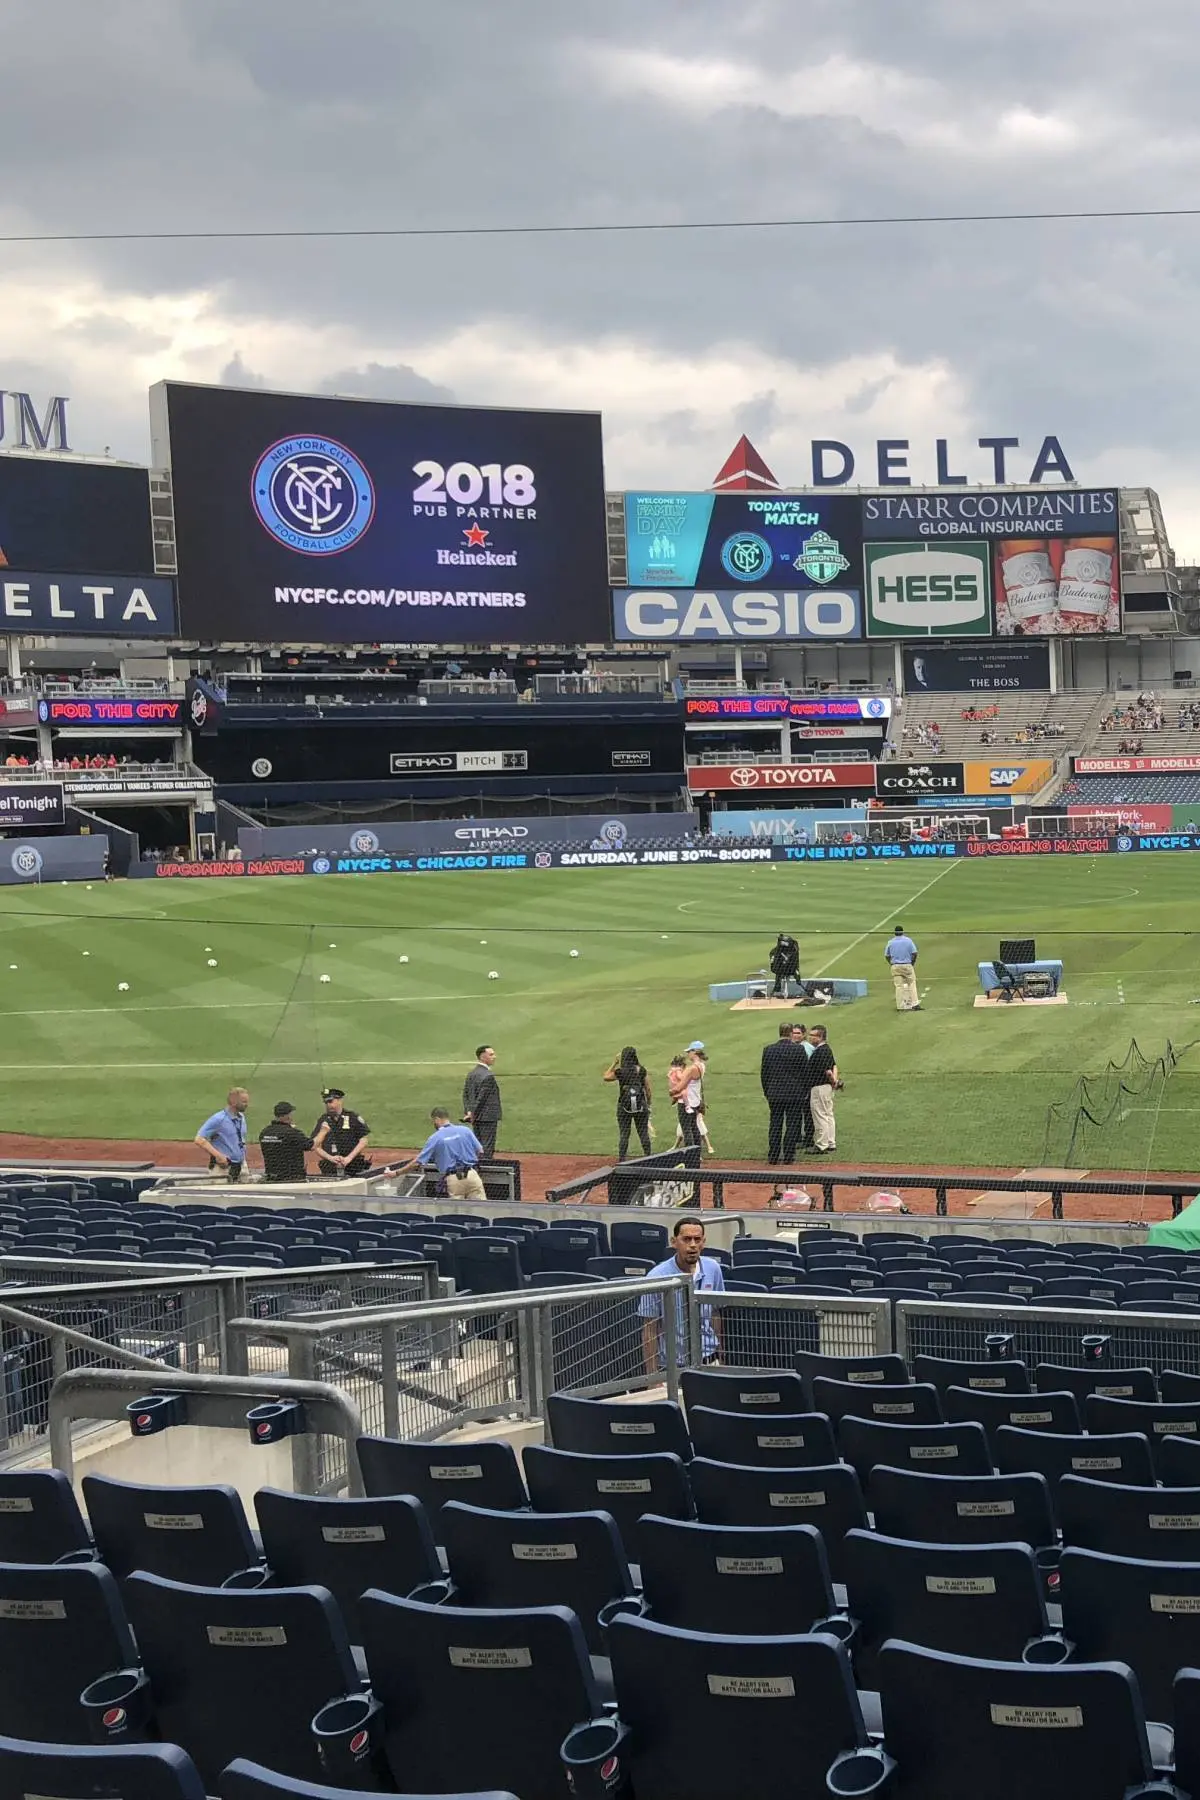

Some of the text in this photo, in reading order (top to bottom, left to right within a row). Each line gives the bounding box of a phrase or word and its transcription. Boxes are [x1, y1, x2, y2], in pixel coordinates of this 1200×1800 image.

[270, 441, 352, 466] NEW YORK CITY
[811, 436, 1075, 486] DELTA
[412, 460, 536, 506] 2018
[636, 497, 674, 505] WELCOME
[747, 501, 800, 512] TODAY'S
[866, 492, 1115, 520] STARR COMPANIES
[413, 504, 537, 519] PUB PARTNER
[637, 505, 687, 517] FAMILY
[765, 512, 819, 525] MATCH
[637, 517, 686, 535] DAY
[919, 519, 1063, 535] GLOBAL INSURANCE
[274, 523, 359, 550] FOOTBALL CLUB
[436, 549, 518, 566] Heineken
[801, 555, 841, 563] TORONTO
[878, 575, 978, 603] HESS
[275, 586, 526, 608] NYCFC.COM/PUBPARTNERS
[624, 592, 856, 636] CASIO
[969, 677, 1020, 688] THE BOSS
[51, 703, 92, 718] FOR
[95, 703, 133, 718] THE
[137, 703, 179, 718] CITY
[687, 701, 719, 713] FOR
[721, 700, 751, 712] THE
[754, 699, 789, 712] CITY
[814, 729, 845, 737] TOYOTA
[395, 755, 496, 768] ETIHAD PITCH
[613, 752, 648, 761] ETIHAD
[1080, 759, 1130, 771] MODELL'S
[761, 768, 836, 783] TOYOTA
[882, 776, 958, 788] COACH
[989, 770, 1018, 785] SAP
[850, 798, 886, 809] FedEx
[455, 826, 529, 839] ETIHAD
[156, 861, 244, 877] UPCOMING
[247, 859, 305, 874] MATCH
[337, 858, 391, 871] NYCFC
[395, 860, 412, 869] vs.
[416, 856, 487, 870] CHICAGO
[492, 854, 527, 867] FIRE
[561, 852, 637, 865] SATURDAY,
[640, 851, 679, 862] JUNE
[785, 847, 825, 859] TUNE
[829, 846, 867, 857] INTO
[871, 845, 906, 857] YES,
[910, 844, 955, 855] WNYE
[967, 839, 1051, 855] UPCOMING
[1054, 839, 1109, 852] MATCH
[1140, 836, 1190, 849] NYCFC
